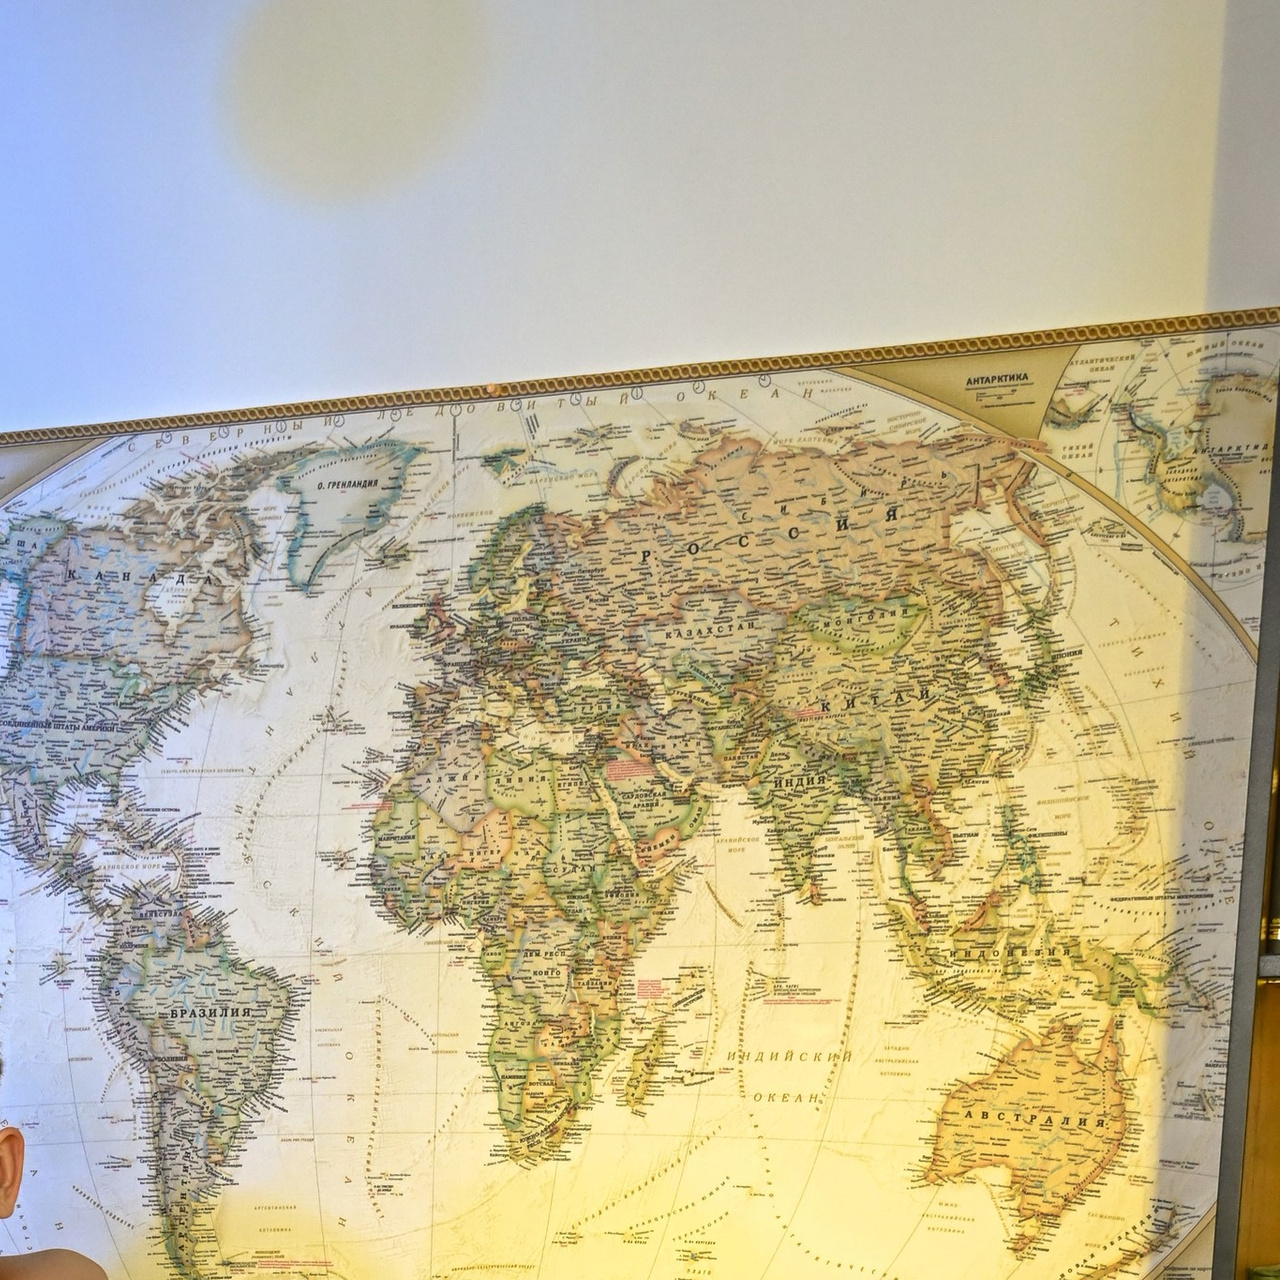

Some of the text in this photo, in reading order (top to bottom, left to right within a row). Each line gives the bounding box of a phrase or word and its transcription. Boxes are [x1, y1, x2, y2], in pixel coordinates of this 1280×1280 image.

[966, 373, 1029, 386] АНТАРКТИКА
[327, 478, 378, 490] ГРЕНЛАНДИЯ
[641, 508, 898, 563] РОССИЯ
[68, 569, 213, 587] КАНАДА
[824, 608, 909, 628] МОНГОЛИЯ
[665, 622, 756, 639] КАЗАХСТАН
[821, 688, 930, 712] КИТАЙ
[426, 774, 480, 783] АЛЖИР
[495, 775, 546, 784] ЛИВИЯ
[774, 775, 825, 788] ИНДИЯ
[949, 948, 1071, 957] ИНДОНЕЗИЯ
[171, 1008, 251, 1018] БРАЗИЛИЯ
[727, 1051, 852, 1062] ИНДИЙСКИЙ
[754, 1093, 818, 1103] ОКЕАН
[965, 1110, 1105, 1127] АВСТРАЛИЯ
